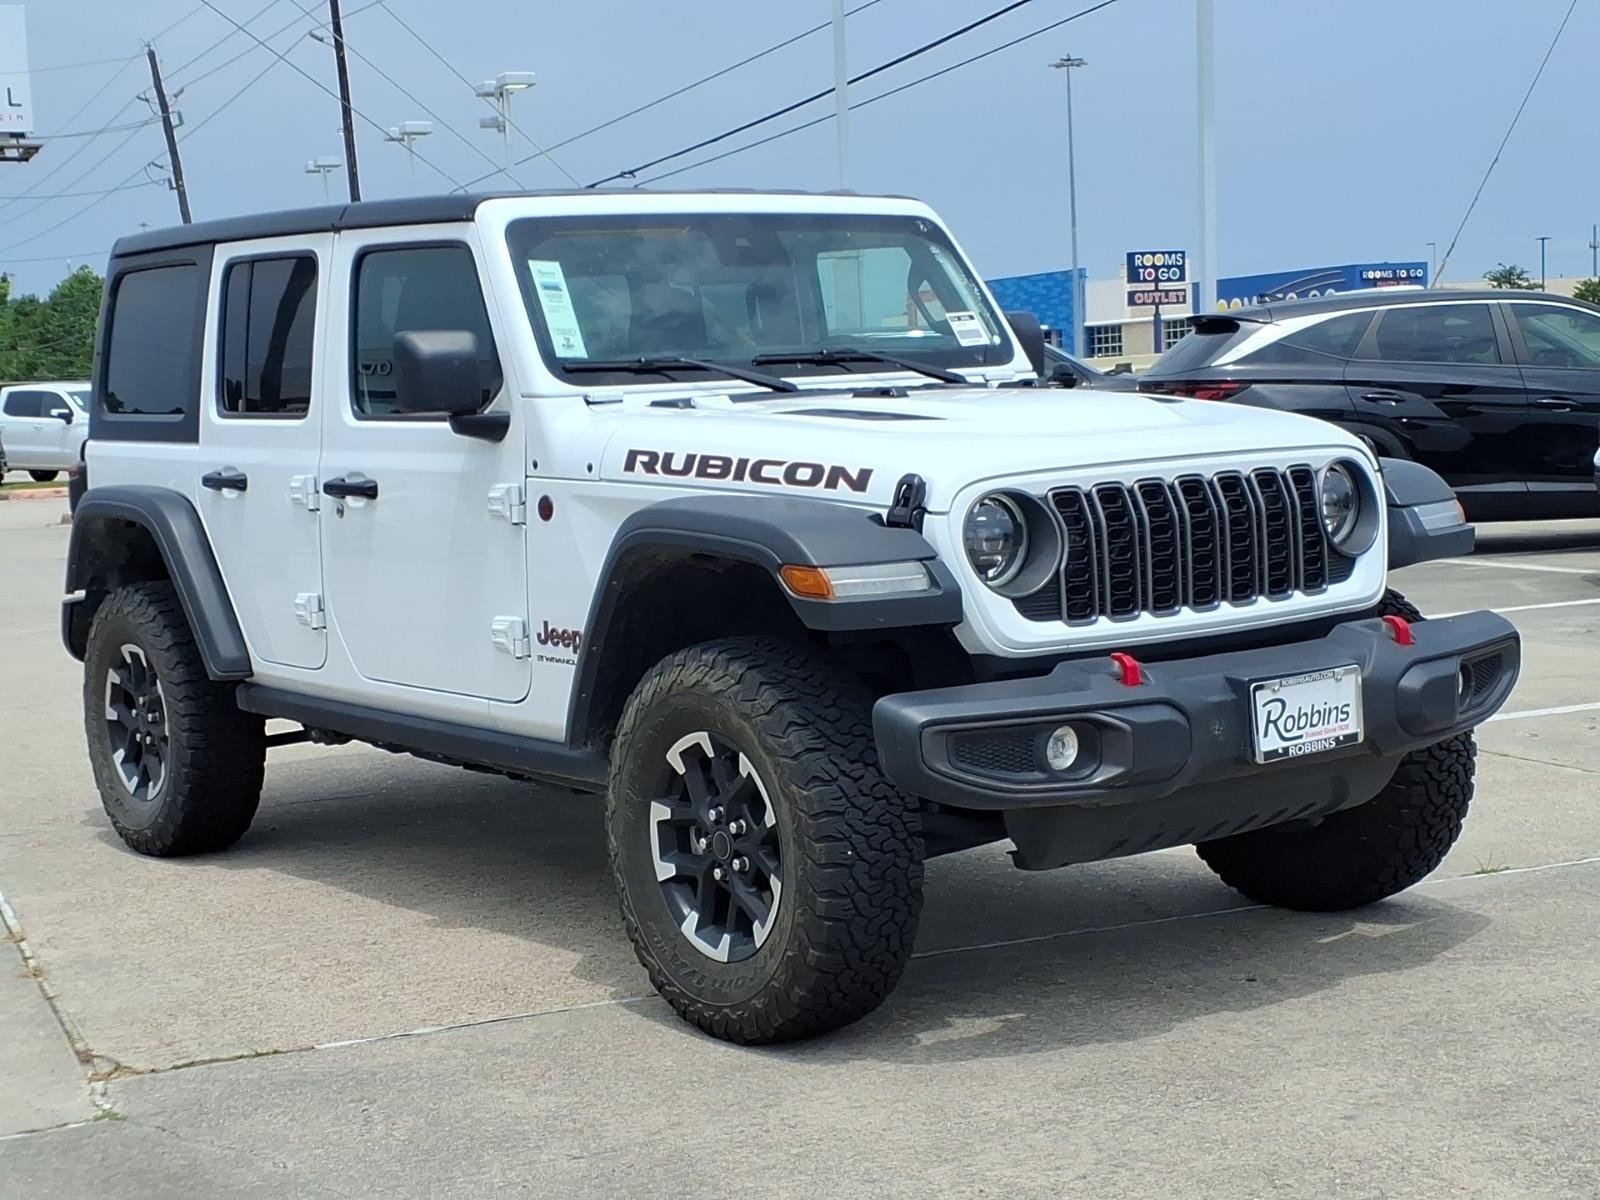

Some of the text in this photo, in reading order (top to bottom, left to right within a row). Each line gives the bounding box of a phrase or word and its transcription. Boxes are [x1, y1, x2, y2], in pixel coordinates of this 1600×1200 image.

[1134, 253, 1183, 267] ROOMS
[1138, 267, 1180, 281] TO GO
[1362, 268, 1424, 279] ROOMS TO GO
[1134, 291, 1185, 304] OUTLET
[623, 449, 874, 493] RUBICON
[536, 620, 582, 655] Jeep
[1262, 698, 1351, 743] Robbins
[1288, 737, 1336, 756] ROBBINS
